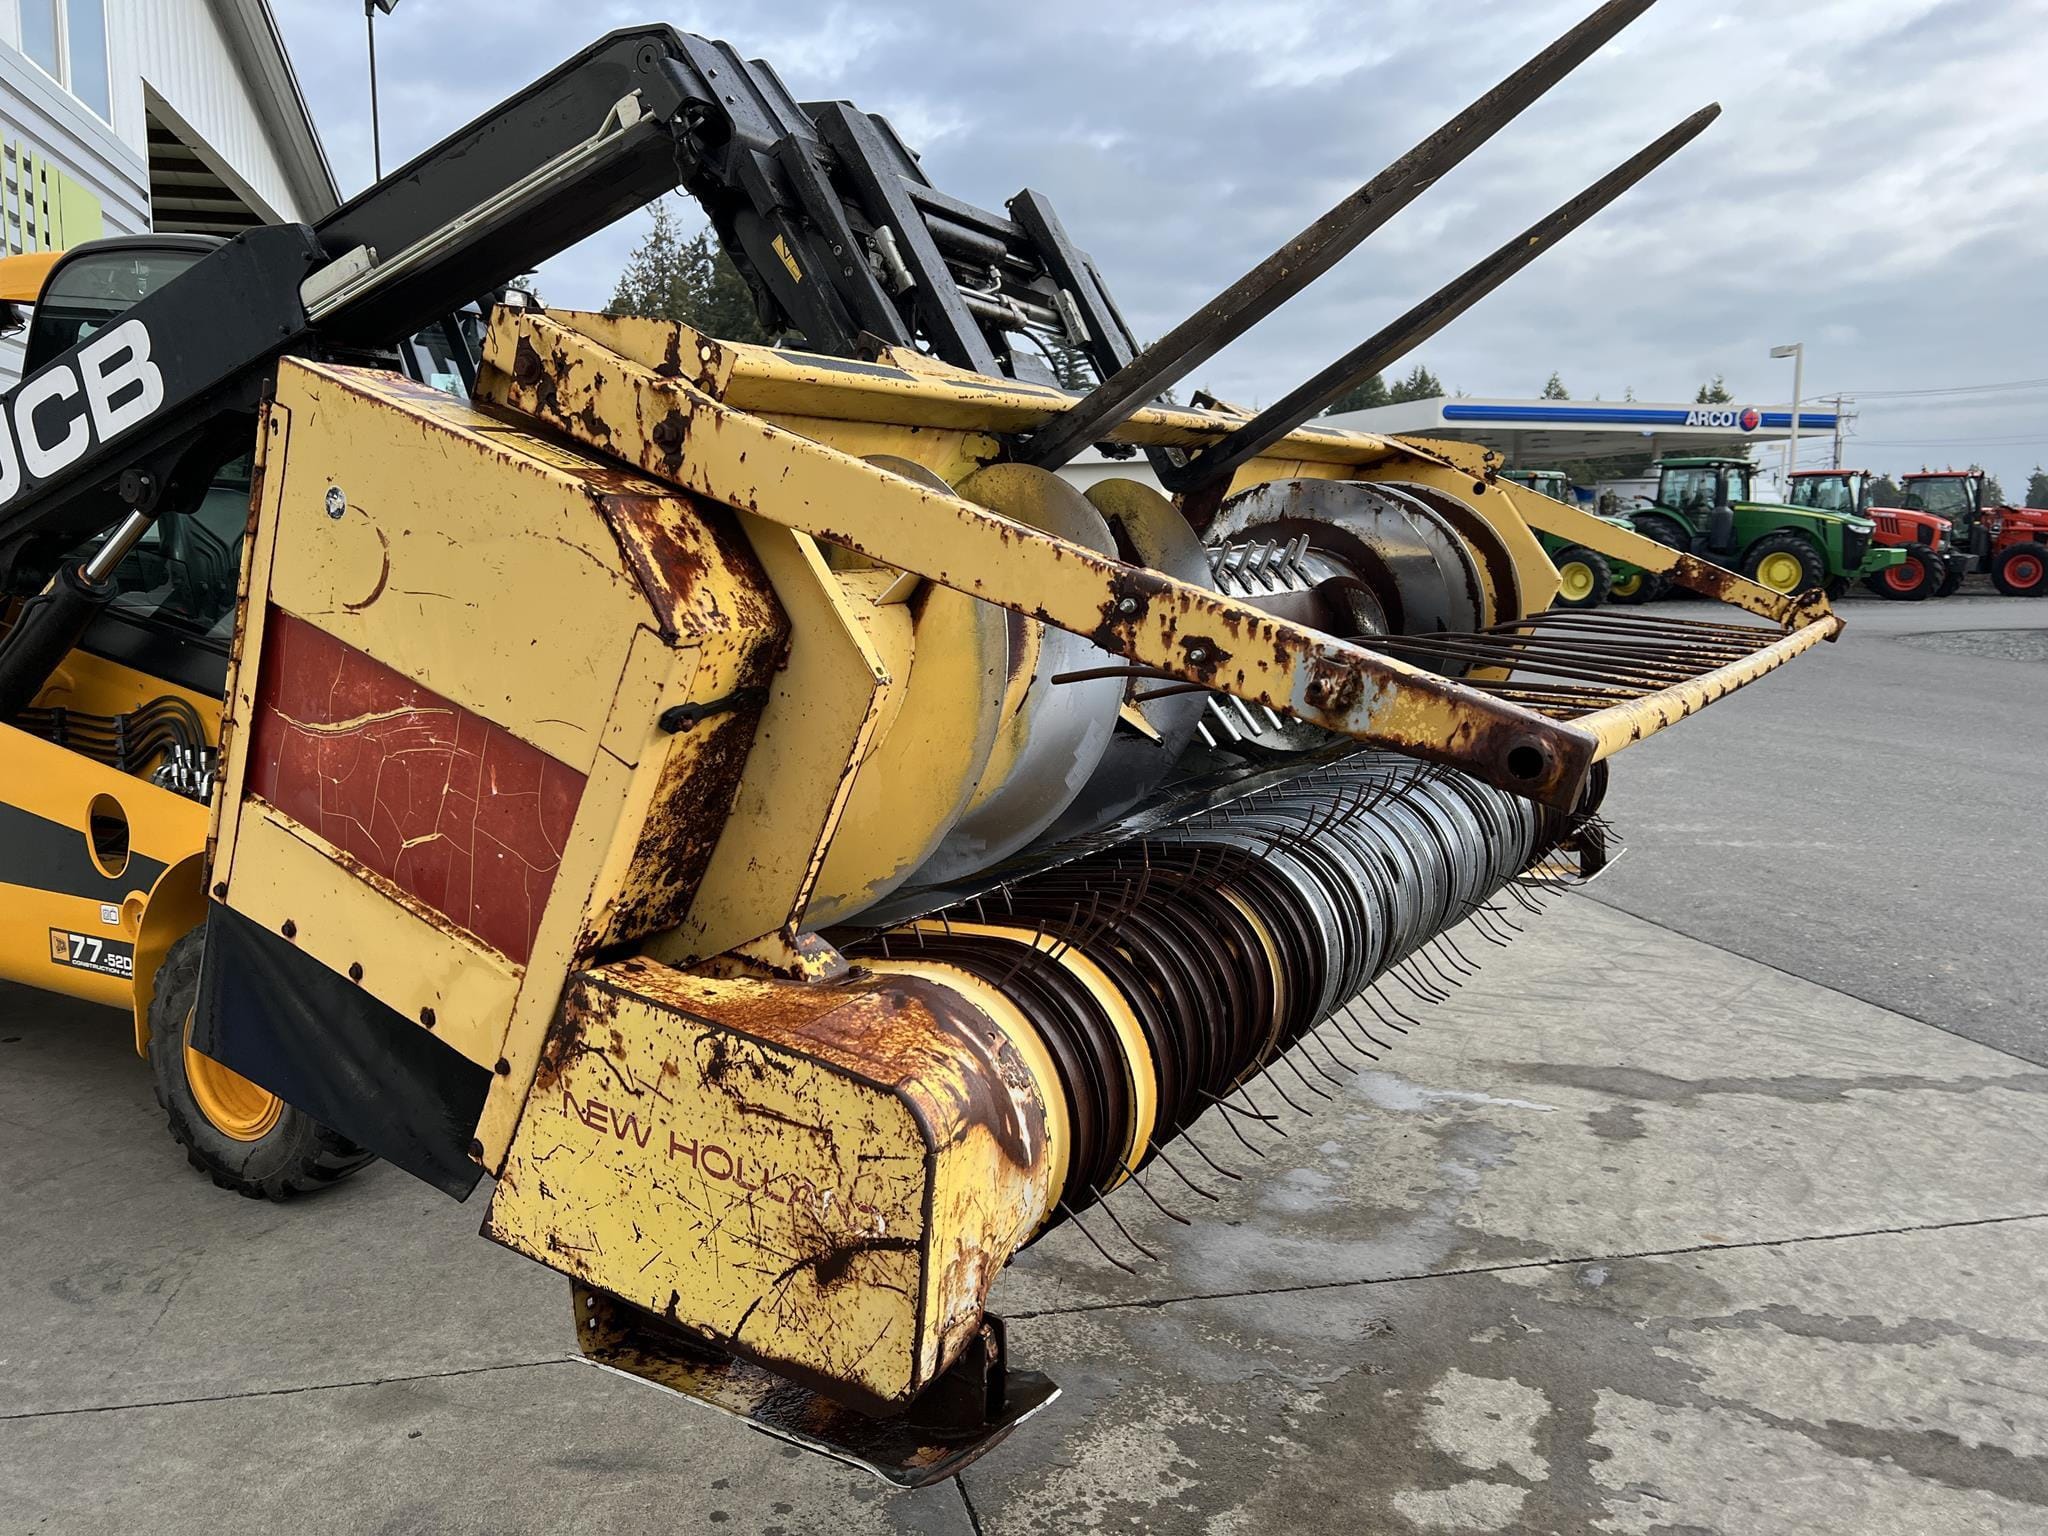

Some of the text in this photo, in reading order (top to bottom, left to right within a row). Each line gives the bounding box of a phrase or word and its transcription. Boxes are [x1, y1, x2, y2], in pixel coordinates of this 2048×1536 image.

[1685, 411, 1734, 427] ARCO
[72, 959, 120, 975] CONSTRUCTION
[563, 1090, 652, 1149] NEW
